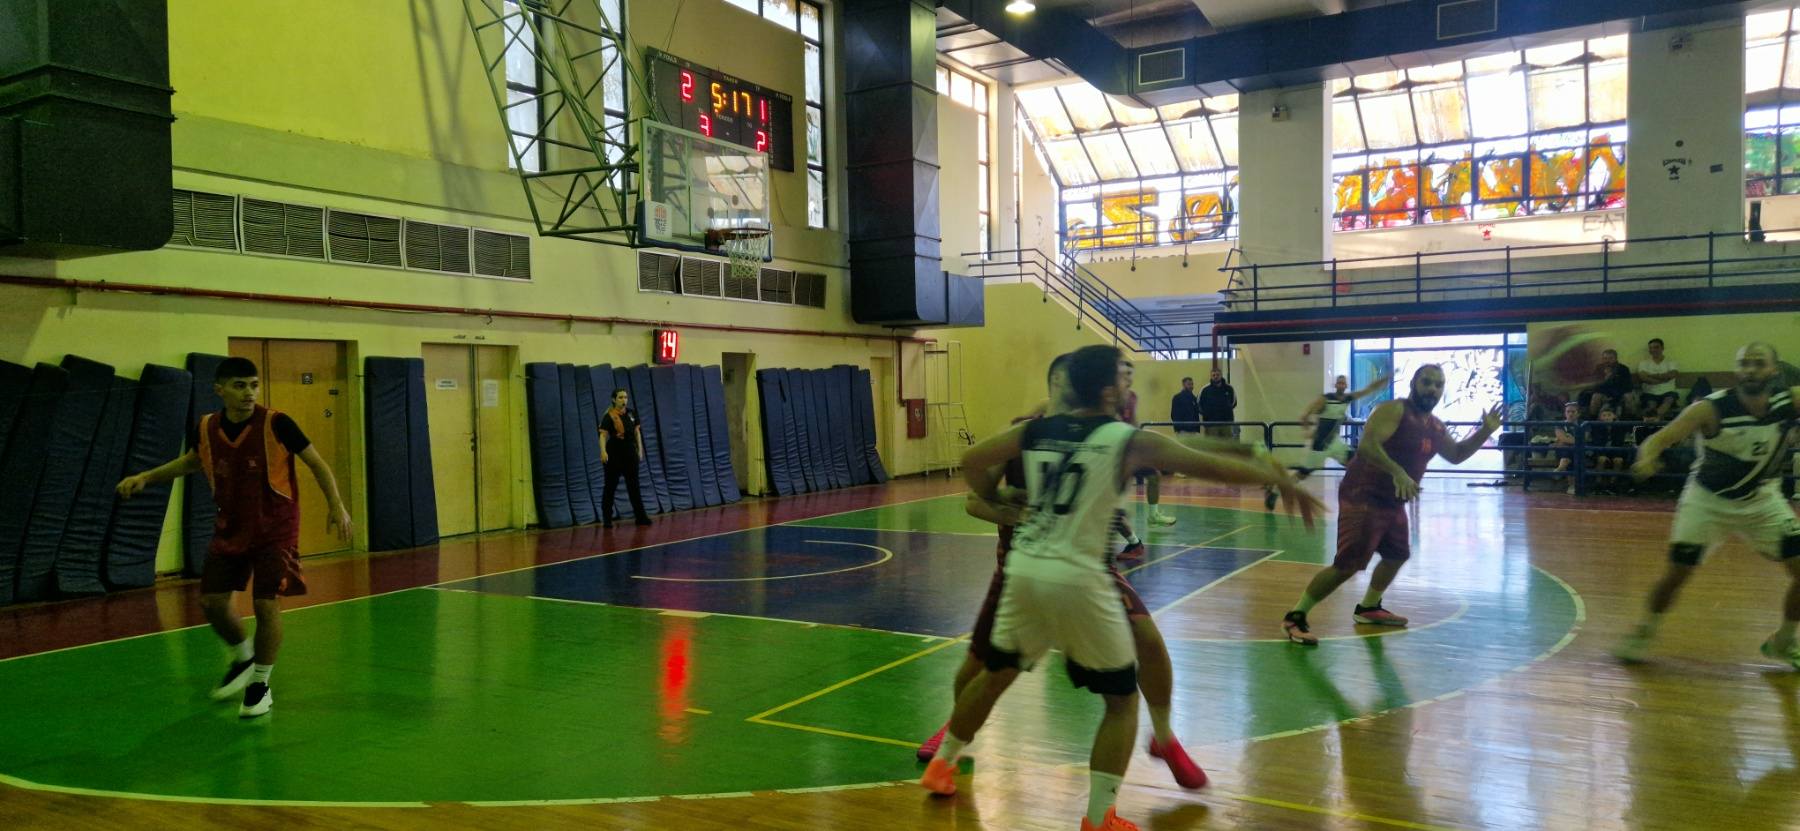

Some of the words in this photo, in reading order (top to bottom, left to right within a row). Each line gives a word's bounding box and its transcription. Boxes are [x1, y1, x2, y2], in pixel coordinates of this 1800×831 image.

[682, 71, 692, 99] 2
[711, 82, 751, 116] 5:17
[661, 331, 677, 358] 14
